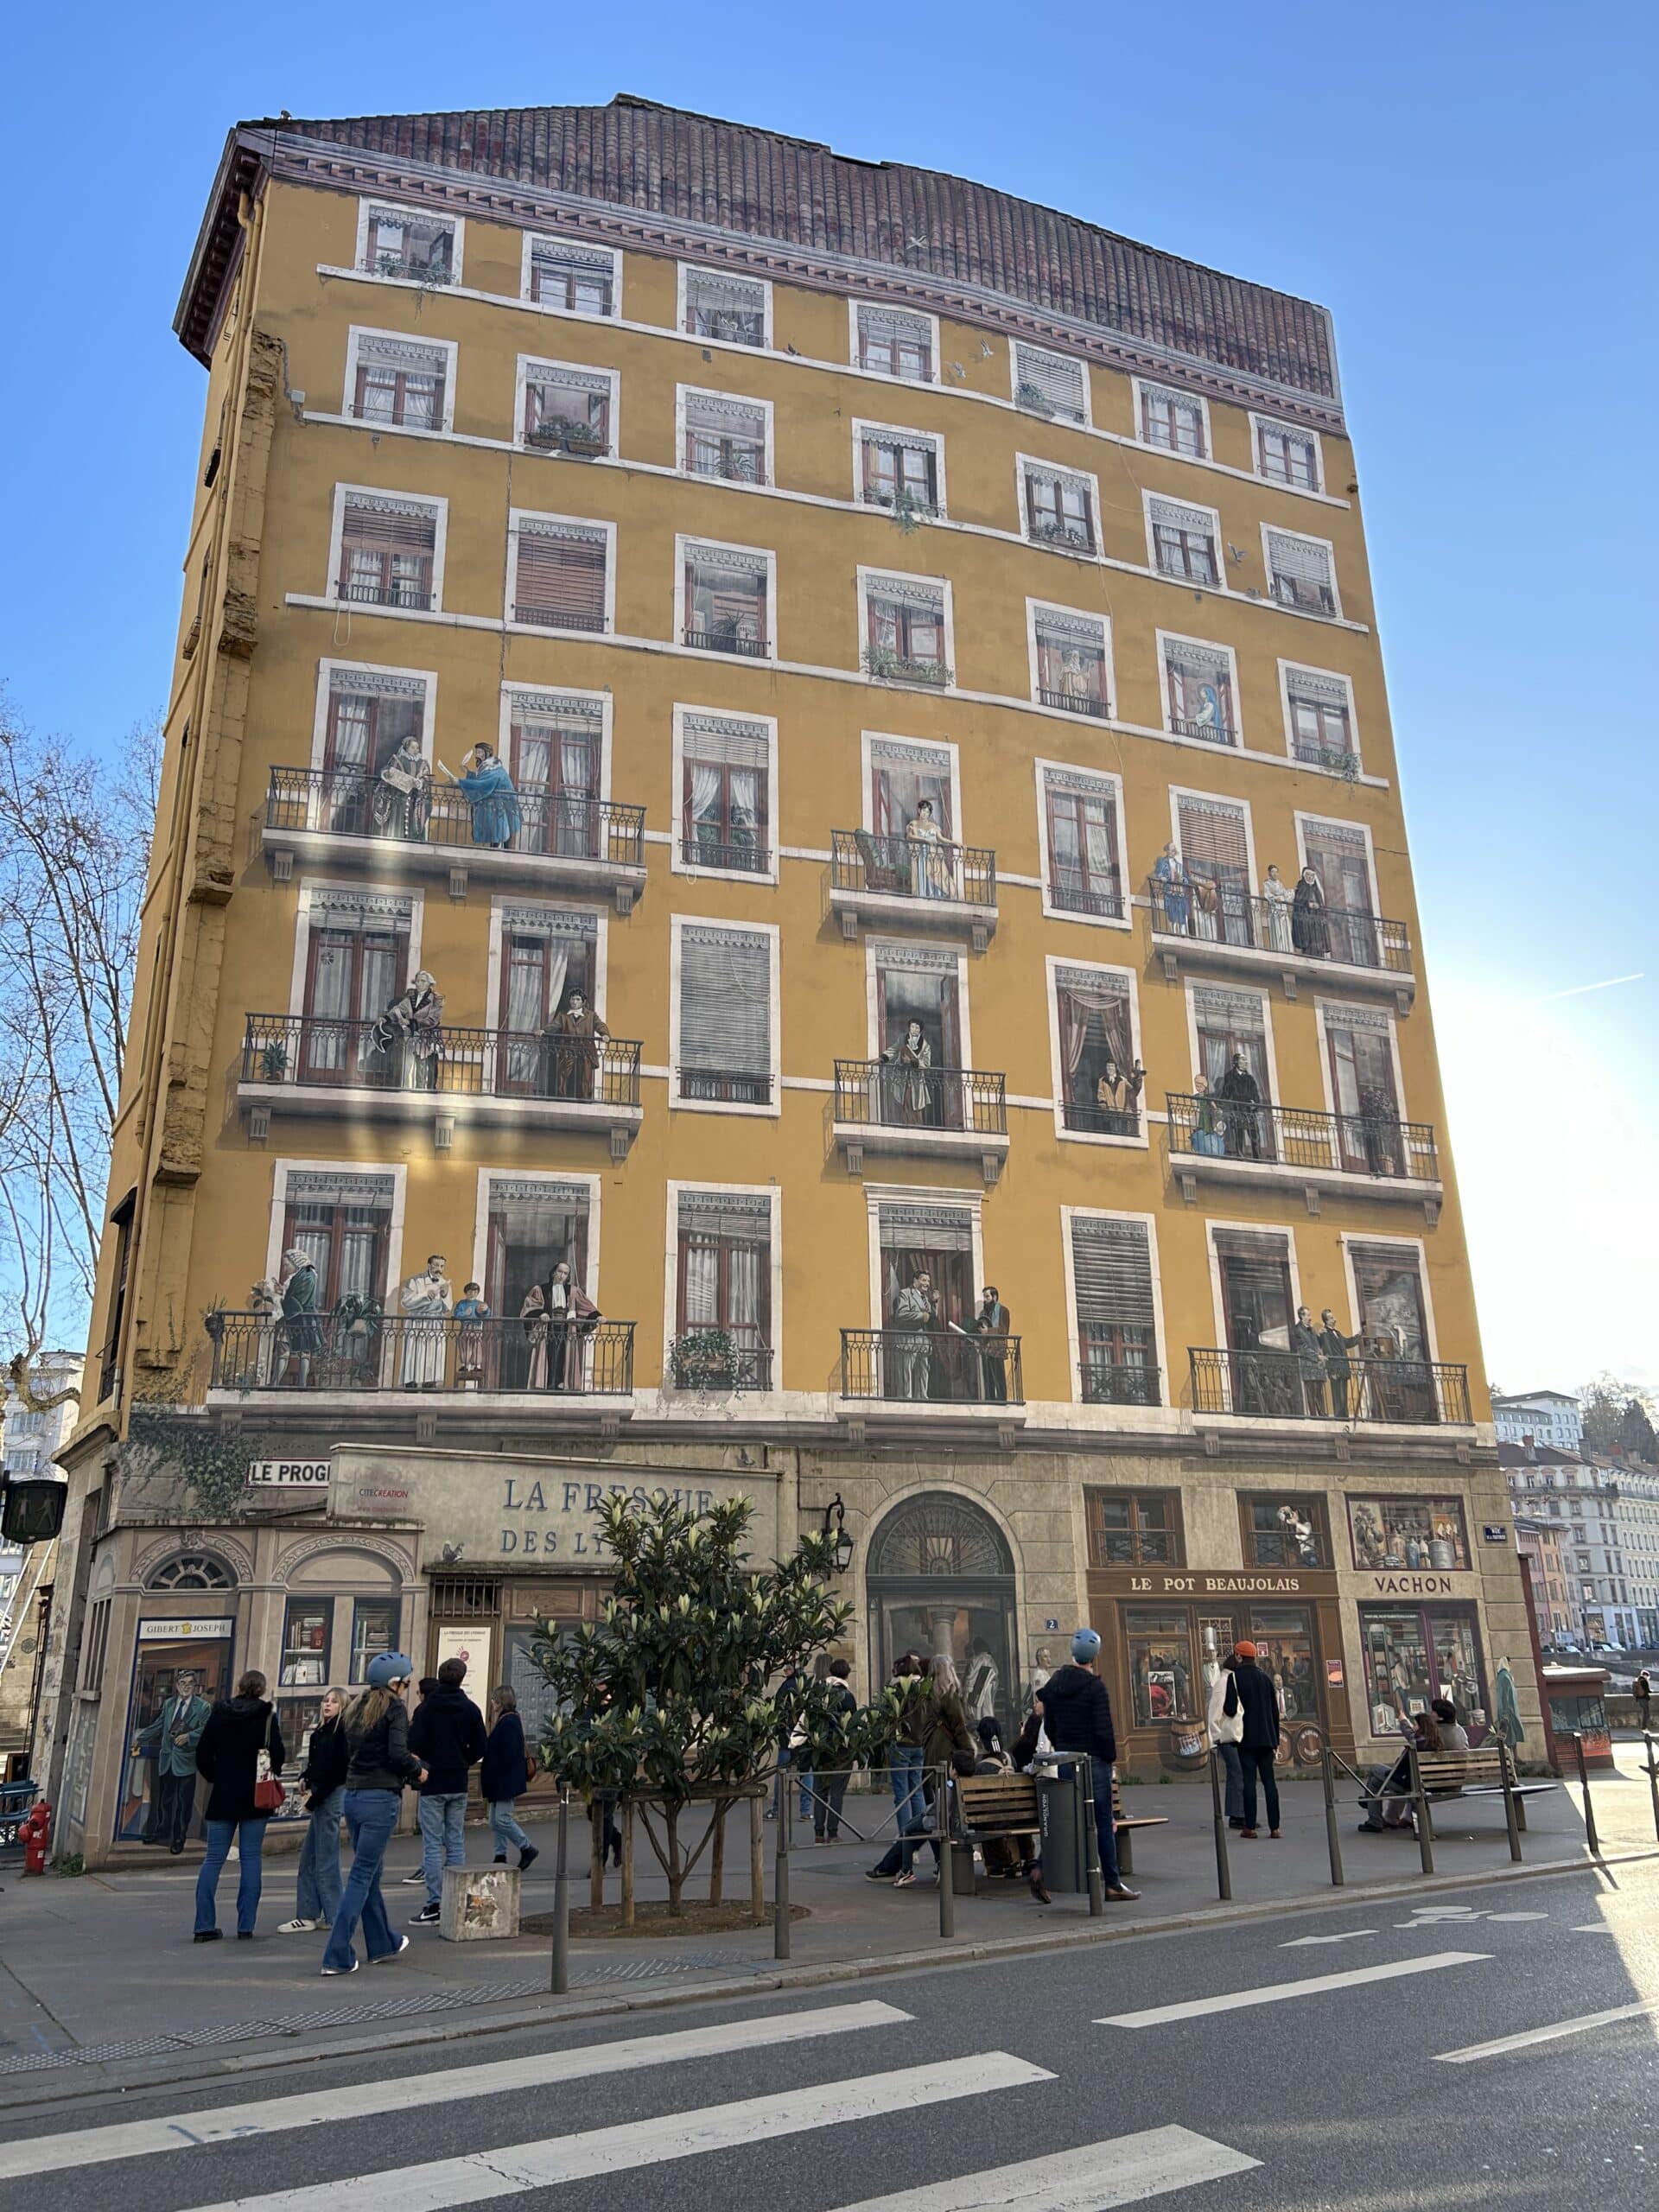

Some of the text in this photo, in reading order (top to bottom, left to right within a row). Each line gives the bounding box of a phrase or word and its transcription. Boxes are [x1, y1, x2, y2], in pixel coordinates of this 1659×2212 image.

[251, 1464, 331, 1482] LE PROG
[504, 1478, 548, 1511] LA
[501, 1529, 557, 1554] DES
[1131, 1578, 1300, 1591] LE POT BEAUJOLAIS
[1375, 1576, 1452, 1593] VACHON
[147, 1624, 226, 1633] GIBERT JOSEPH
[1049, 1620, 1055, 1629] 2
